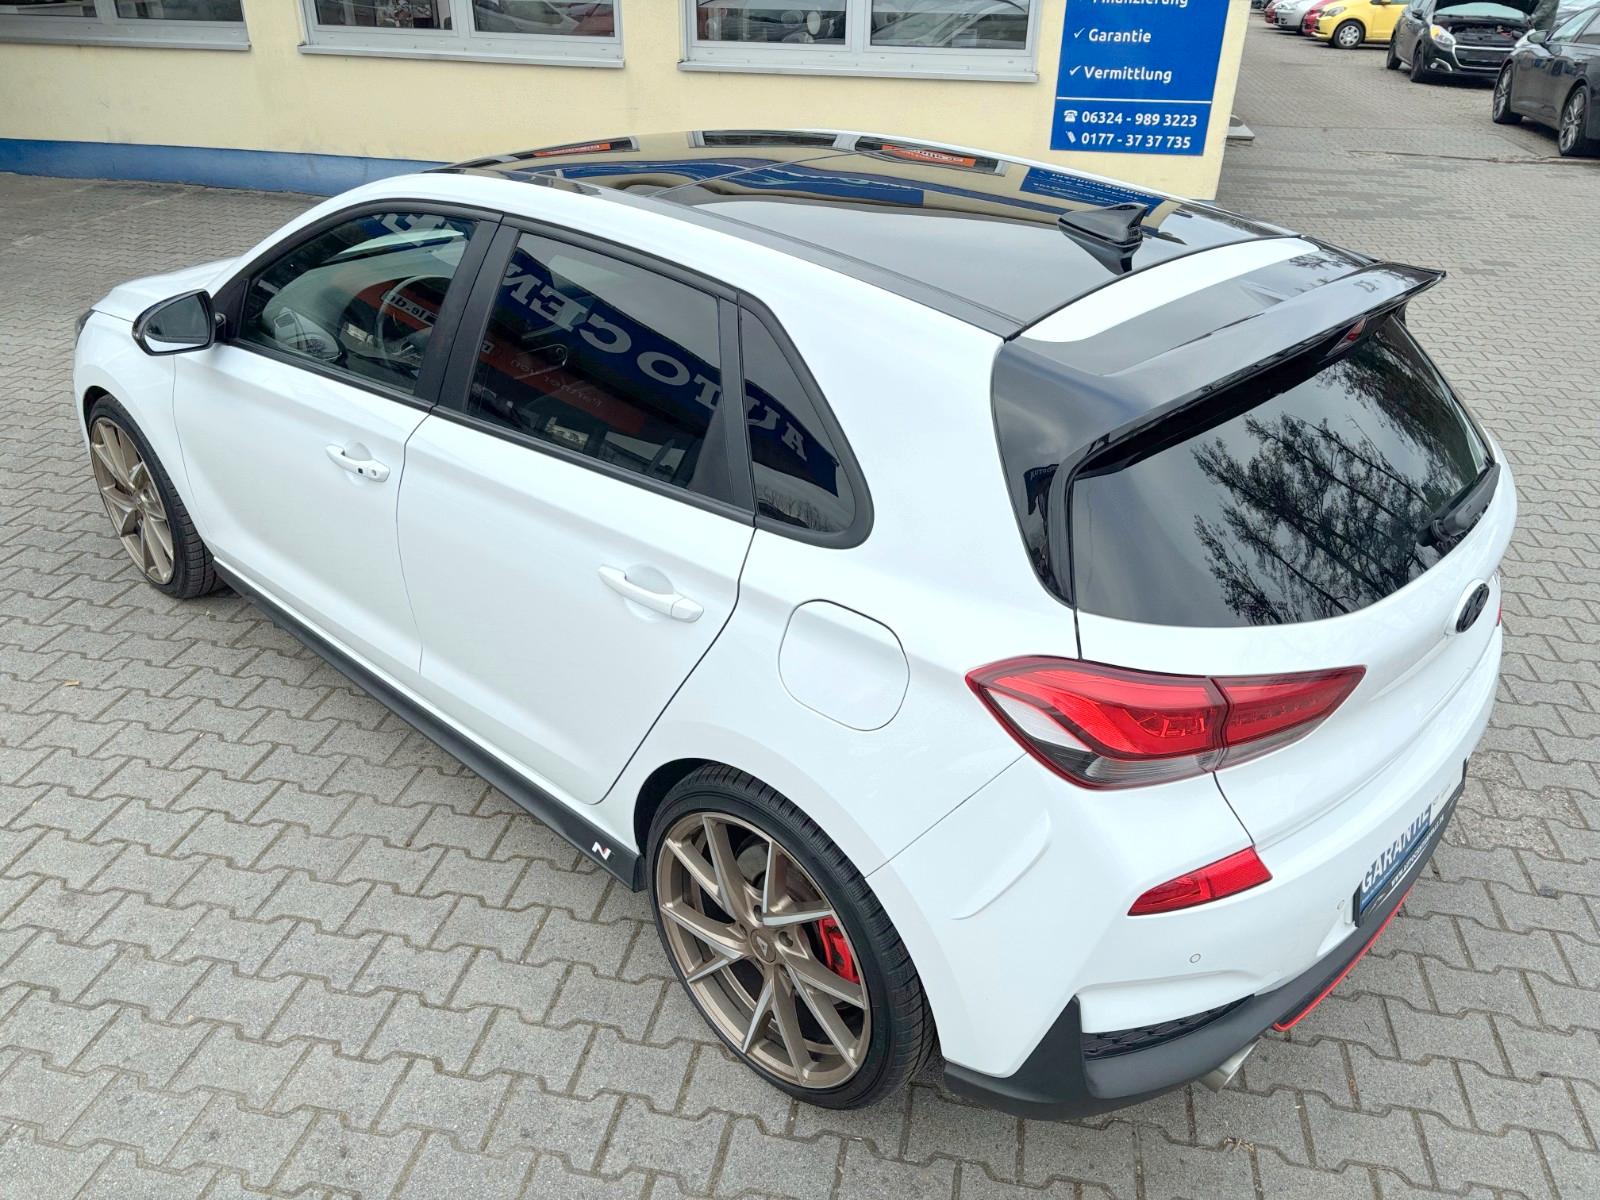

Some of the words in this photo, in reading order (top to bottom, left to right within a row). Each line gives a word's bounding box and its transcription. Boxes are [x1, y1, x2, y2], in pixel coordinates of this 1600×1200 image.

[1088, 28, 1152, 43] Garantie
[1084, 66, 1173, 84] Vermittlung
[1081, 111, 1123, 125] 06324
[1134, 113, 1160, 126] 989
[1162, 114, 1198, 128] 3223
[1081, 132, 1115, 145] 0177
[1124, 134, 1143, 147] 37
[1145, 135, 1163, 148] 37
[1166, 136, 1191, 149] 735
